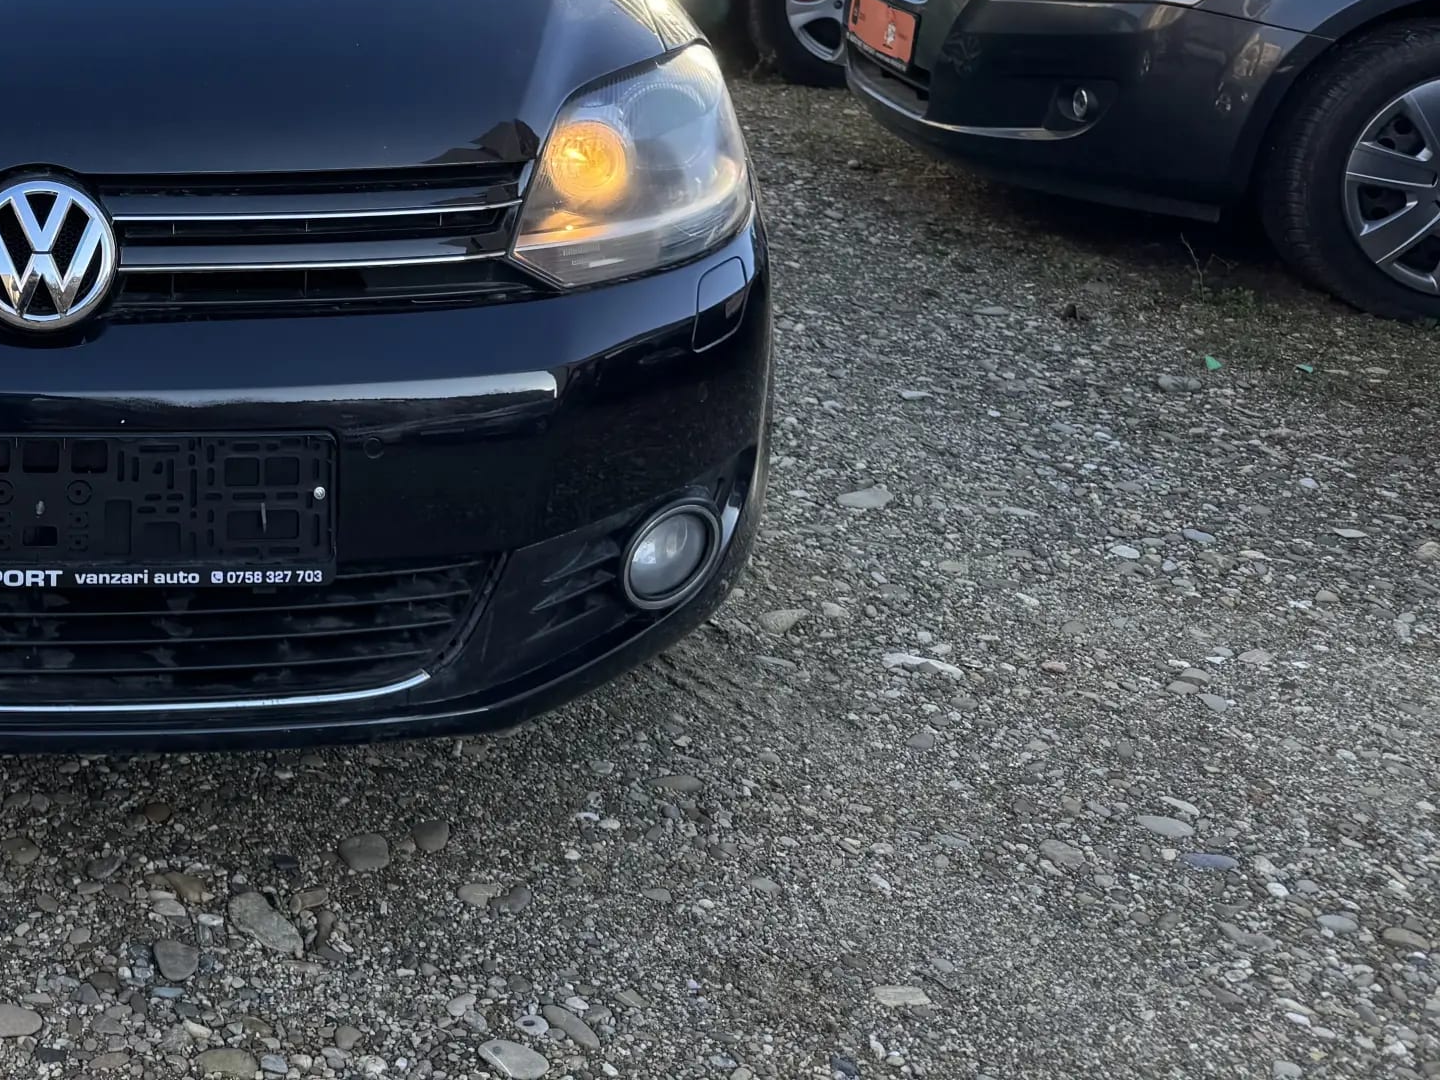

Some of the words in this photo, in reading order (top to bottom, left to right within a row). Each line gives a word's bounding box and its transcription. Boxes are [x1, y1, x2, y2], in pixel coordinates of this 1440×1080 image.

[74, 570, 149, 584] vanzari
[153, 571, 200, 584] auto
[226, 571, 262, 584] 0758
[265, 571, 292, 583] 327
[296, 570, 323, 583] 703
